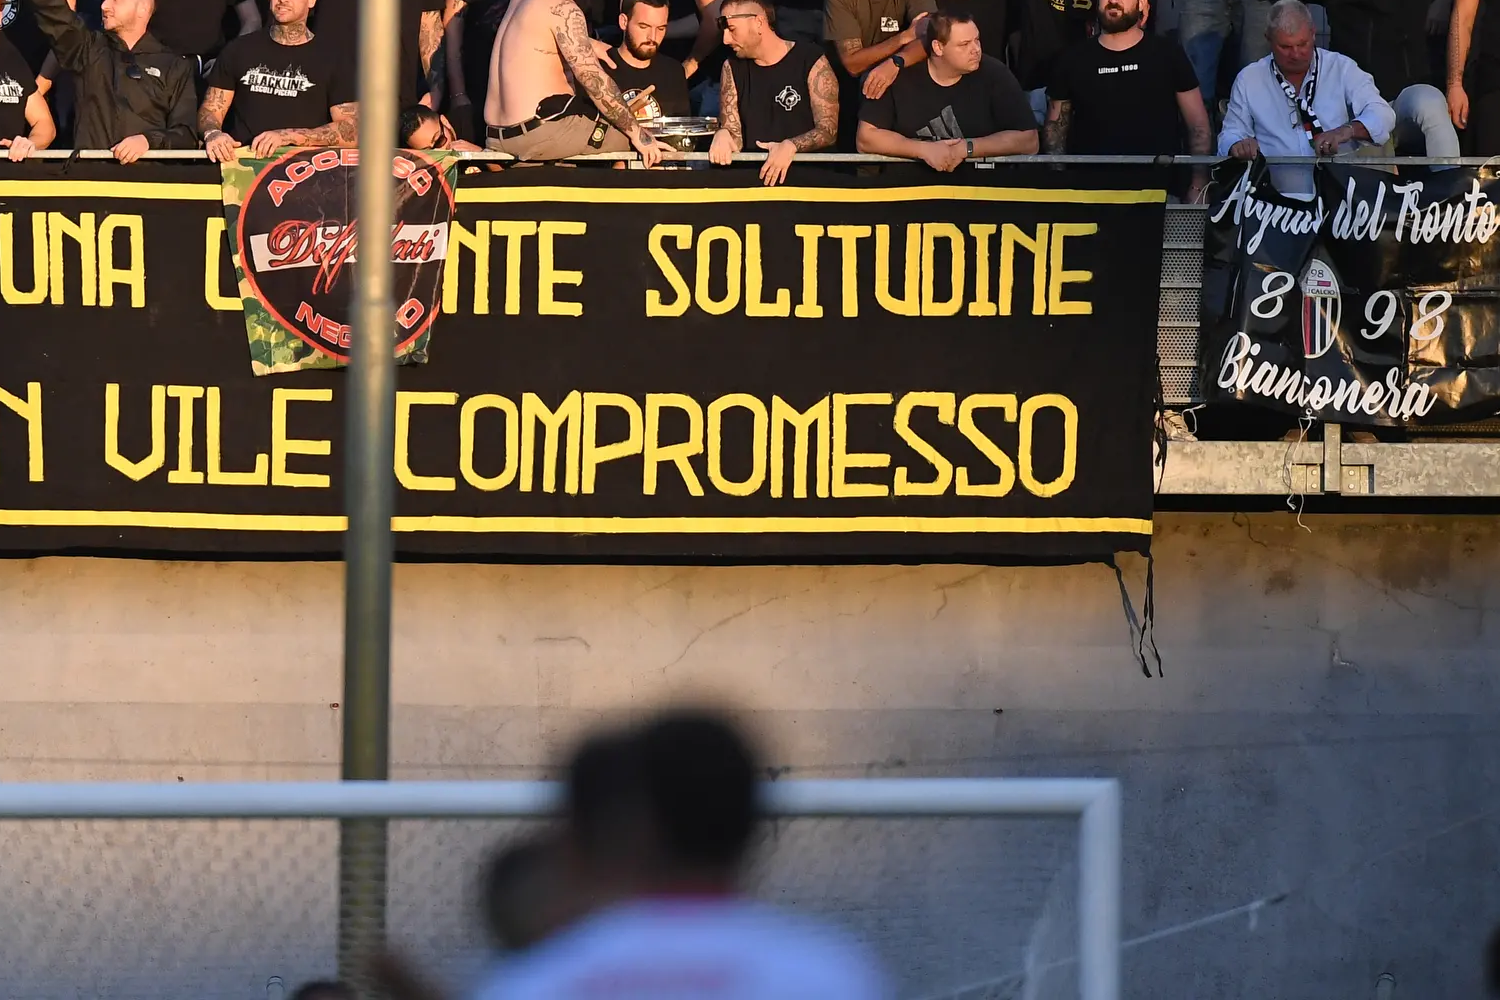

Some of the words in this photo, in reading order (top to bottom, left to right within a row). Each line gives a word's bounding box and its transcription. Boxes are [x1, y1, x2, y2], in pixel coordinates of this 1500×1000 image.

[247, 73, 306, 91] BLACKLINE
[250, 85, 273, 94] ASCOLI
[274, 89, 298, 98] PICENO
[266, 148, 434, 207] ACCESO
[1331, 176, 1389, 242] del
[1392, 177, 1500, 244] Tronto
[205, 216, 587, 317] CNTE
[645, 221, 1099, 318] SOLITUDINE
[266, 219, 440, 295] Diffati
[1311, 288, 1336, 296] CALCIO
[294, 297, 425, 350] NEGO
[104, 381, 332, 488] VILE
[393, 389, 1079, 499] COMPROMESSO
